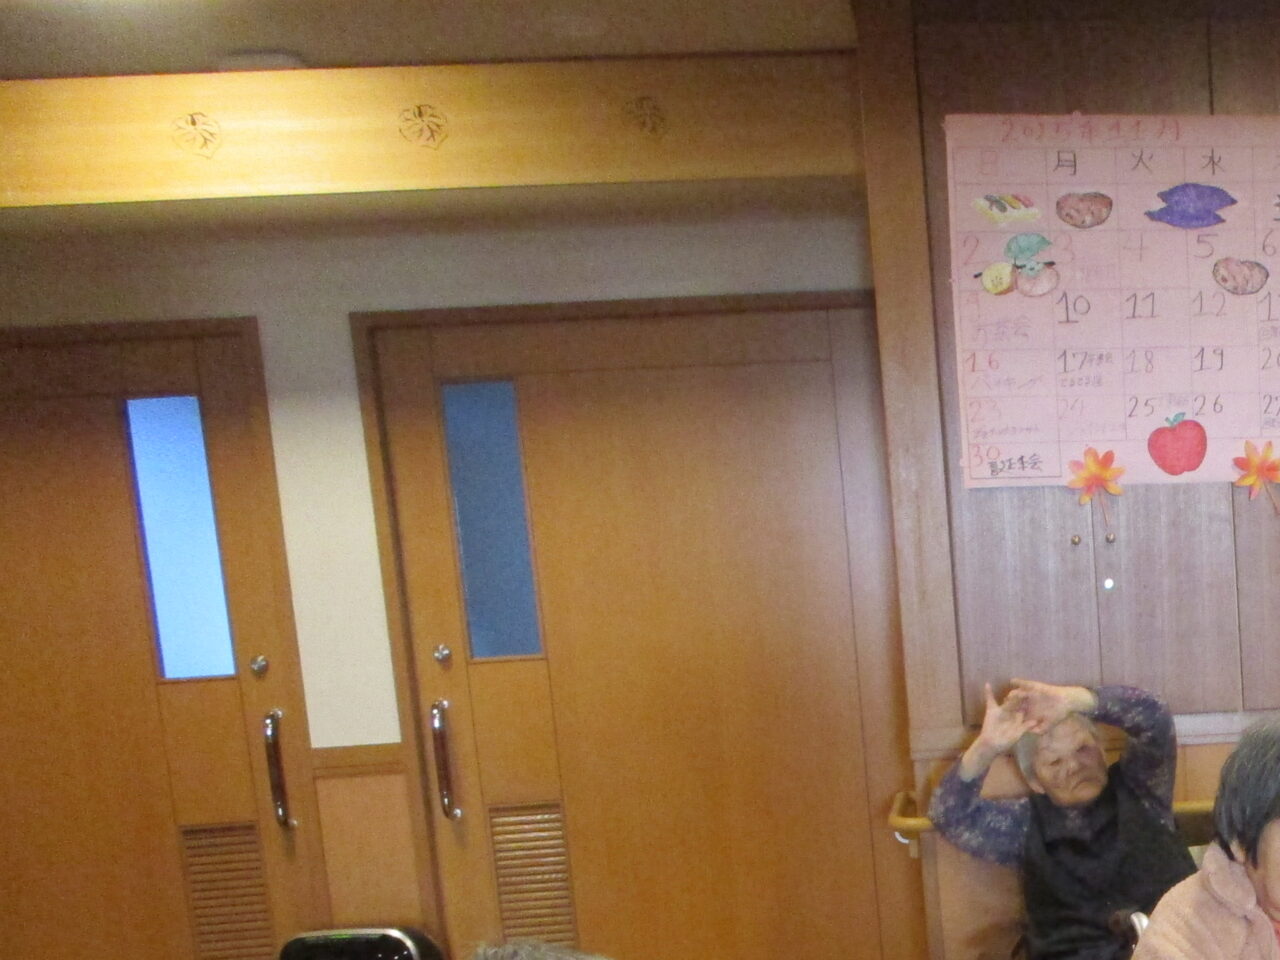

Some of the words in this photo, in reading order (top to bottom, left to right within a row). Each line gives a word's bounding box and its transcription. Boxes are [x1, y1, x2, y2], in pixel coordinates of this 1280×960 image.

[1053, 150, 1077, 176] 月
[1131, 148, 1153, 174] 火
[1201, 148, 1226, 176] 水
[1123, 235, 1149, 261] 4
[1194, 233, 1218, 259] 5
[1261, 229, 1278, 257] 6
[1055, 291, 1091, 325] 10
[1125, 291, 1159, 320] 11
[1191, 290, 1227, 317] 12
[965, 351, 999, 373] 16
[1056, 349, 1088, 374] 17
[1126, 349, 1155, 374] 18
[1193, 346, 1224, 372] 19
[1127, 394, 1157, 419] 25
[1193, 394, 1224, 416] 26
[970, 444, 1001, 467] 30
